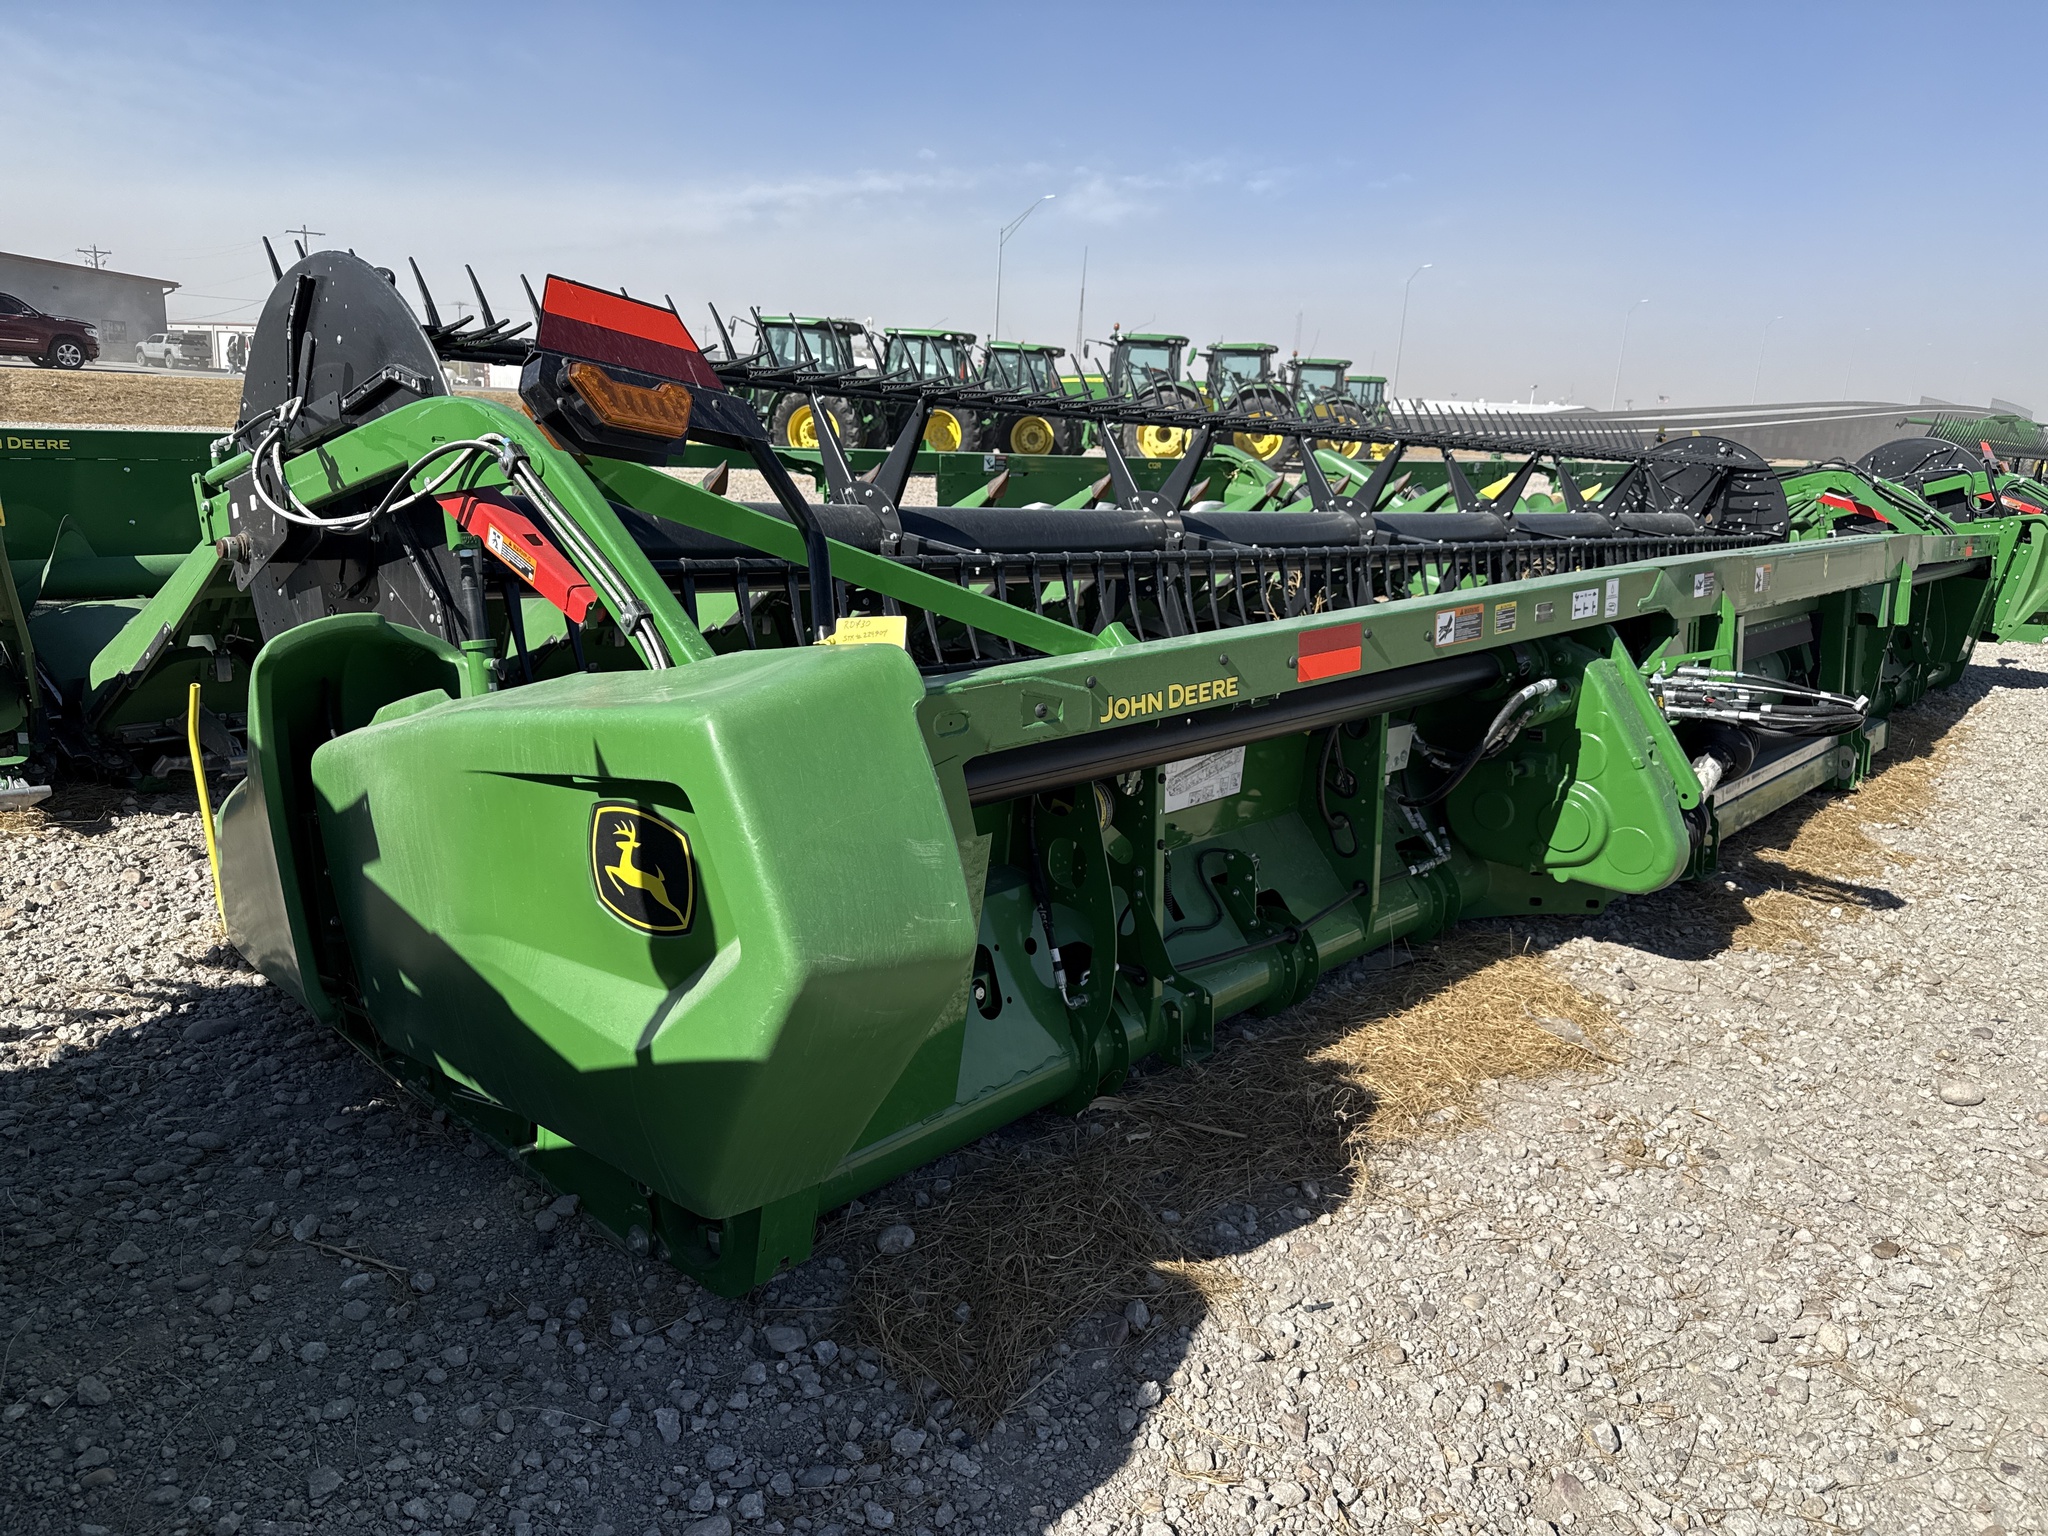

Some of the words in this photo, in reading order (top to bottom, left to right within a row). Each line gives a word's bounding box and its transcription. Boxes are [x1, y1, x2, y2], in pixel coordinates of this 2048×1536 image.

[7, 436, 70, 449] DEERE
[1100, 691, 1163, 723] JOHN
[1168, 676, 1239, 709] DEERE
